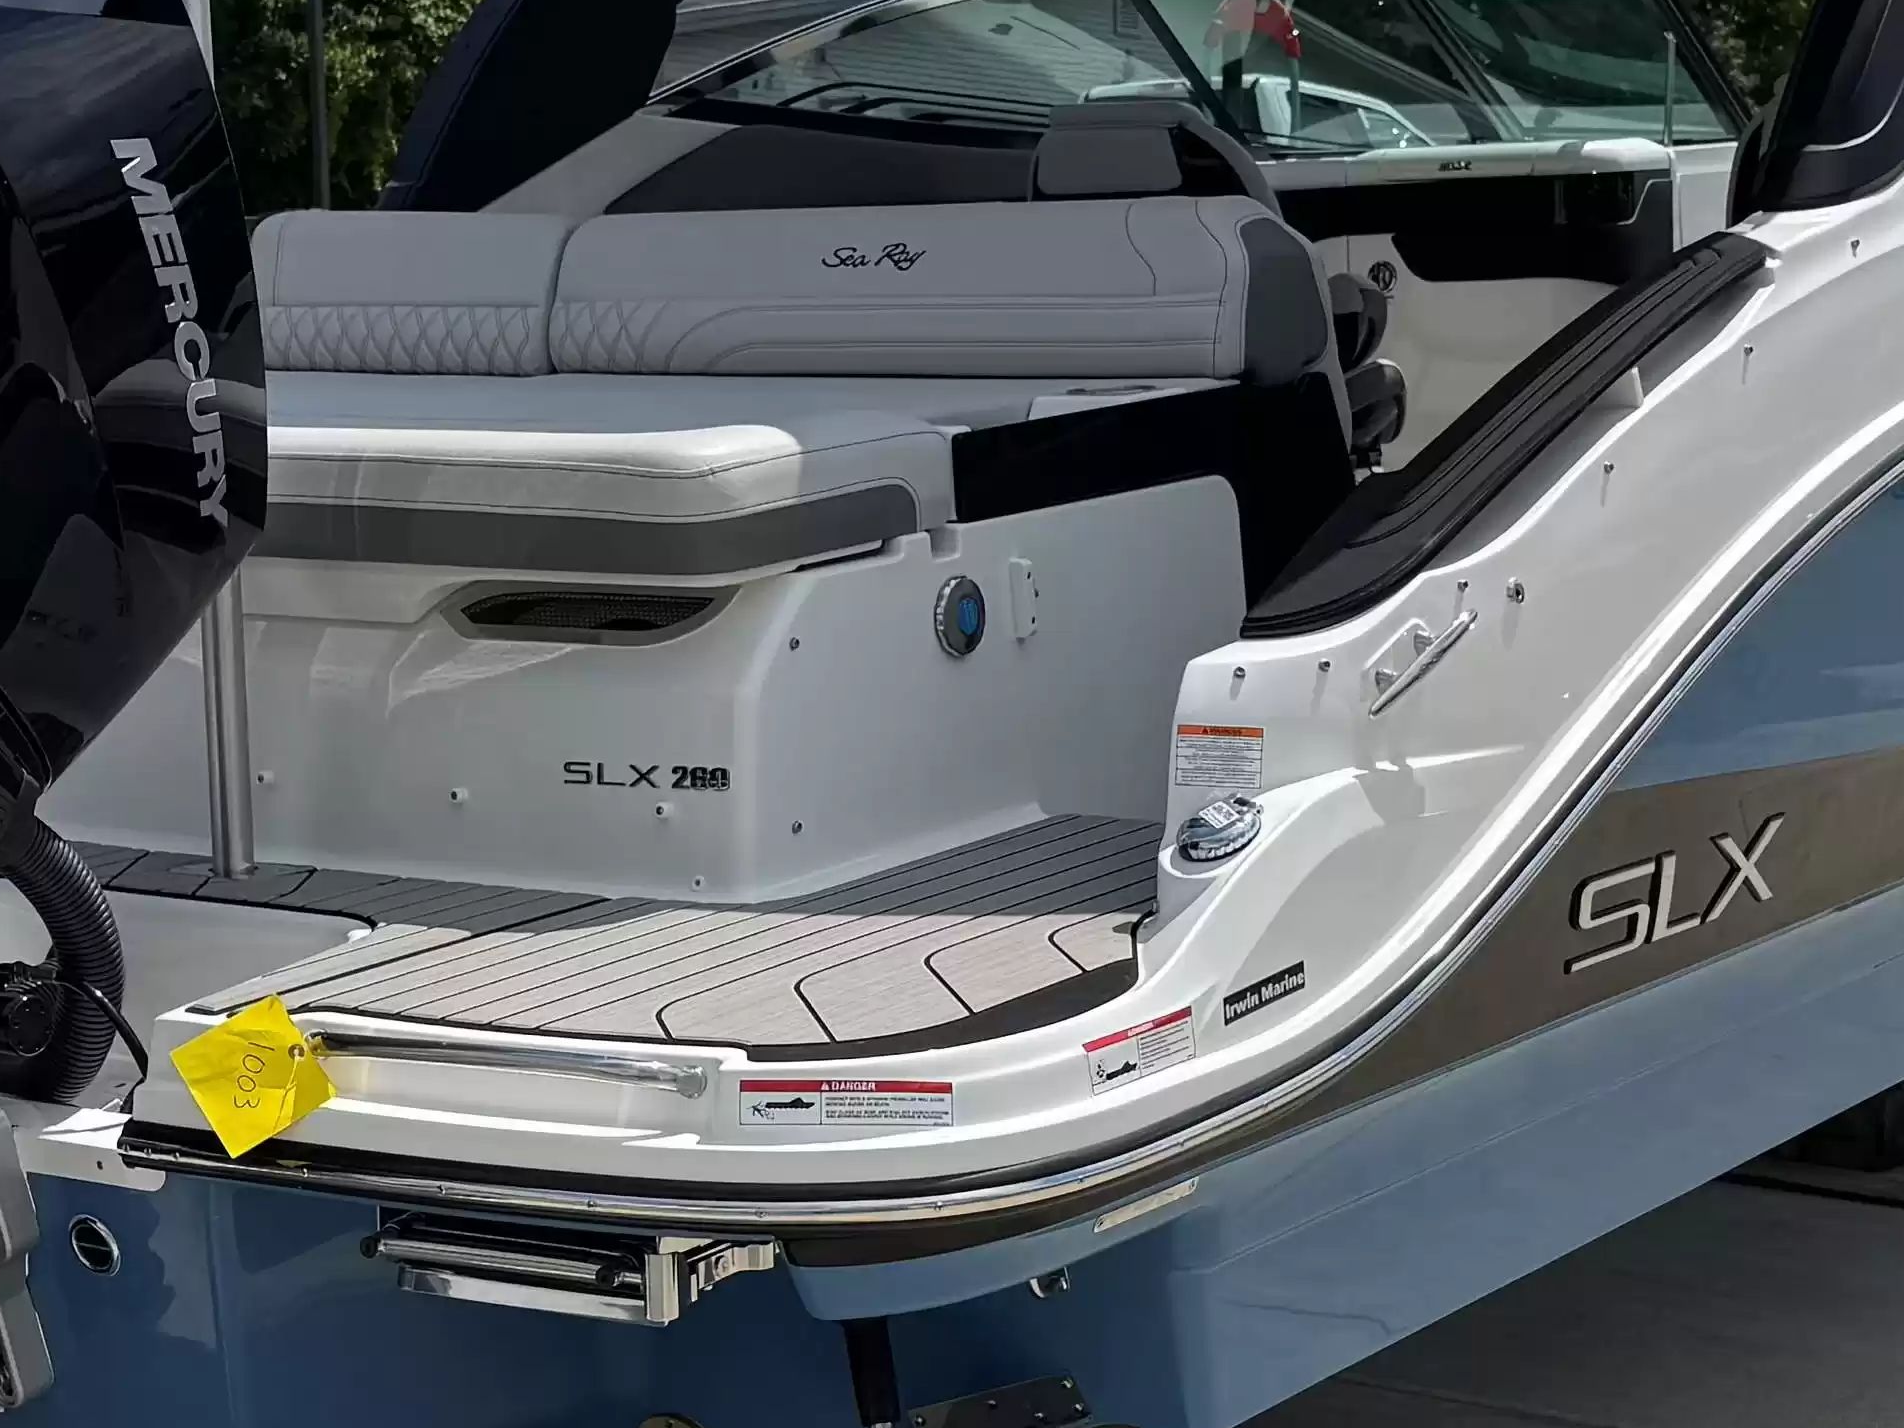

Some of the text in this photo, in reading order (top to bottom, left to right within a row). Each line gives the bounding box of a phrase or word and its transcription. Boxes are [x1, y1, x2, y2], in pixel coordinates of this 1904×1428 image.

[821, 241, 927, 271] Sea Ray
[110, 137, 229, 529] MERCURY
[563, 761, 661, 789] SLX
[1563, 811, 1787, 975] SLX
[1225, 972, 1305, 1020] Irwin Marine
[831, 1081, 876, 1091] DANGER
